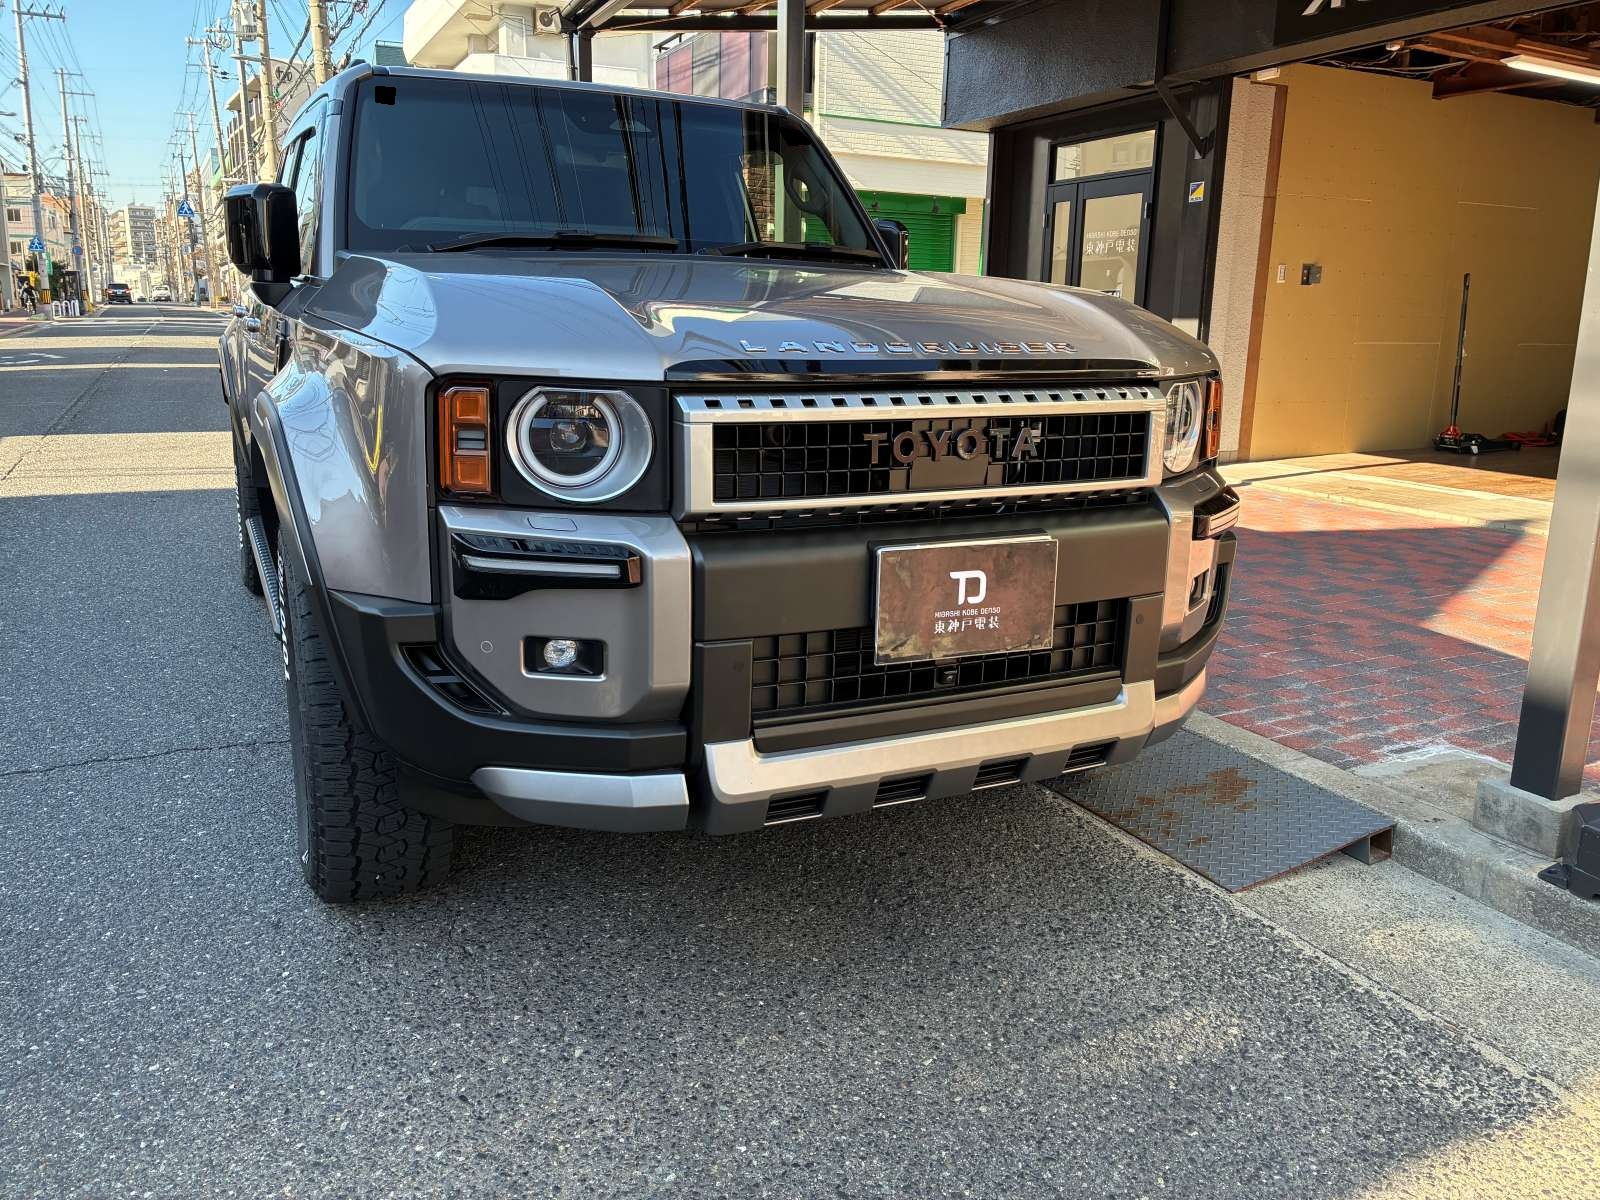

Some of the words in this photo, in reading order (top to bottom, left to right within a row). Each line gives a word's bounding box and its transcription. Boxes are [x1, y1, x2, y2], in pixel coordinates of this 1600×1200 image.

[1085, 238, 1137, 255] 東神戸電装
[863, 427, 1038, 464] TOYOTA
[934, 610, 961, 618] HIGASHI
[962, 608, 979, 616] KOBE
[933, 615, 1001, 634] 東神戸電装
